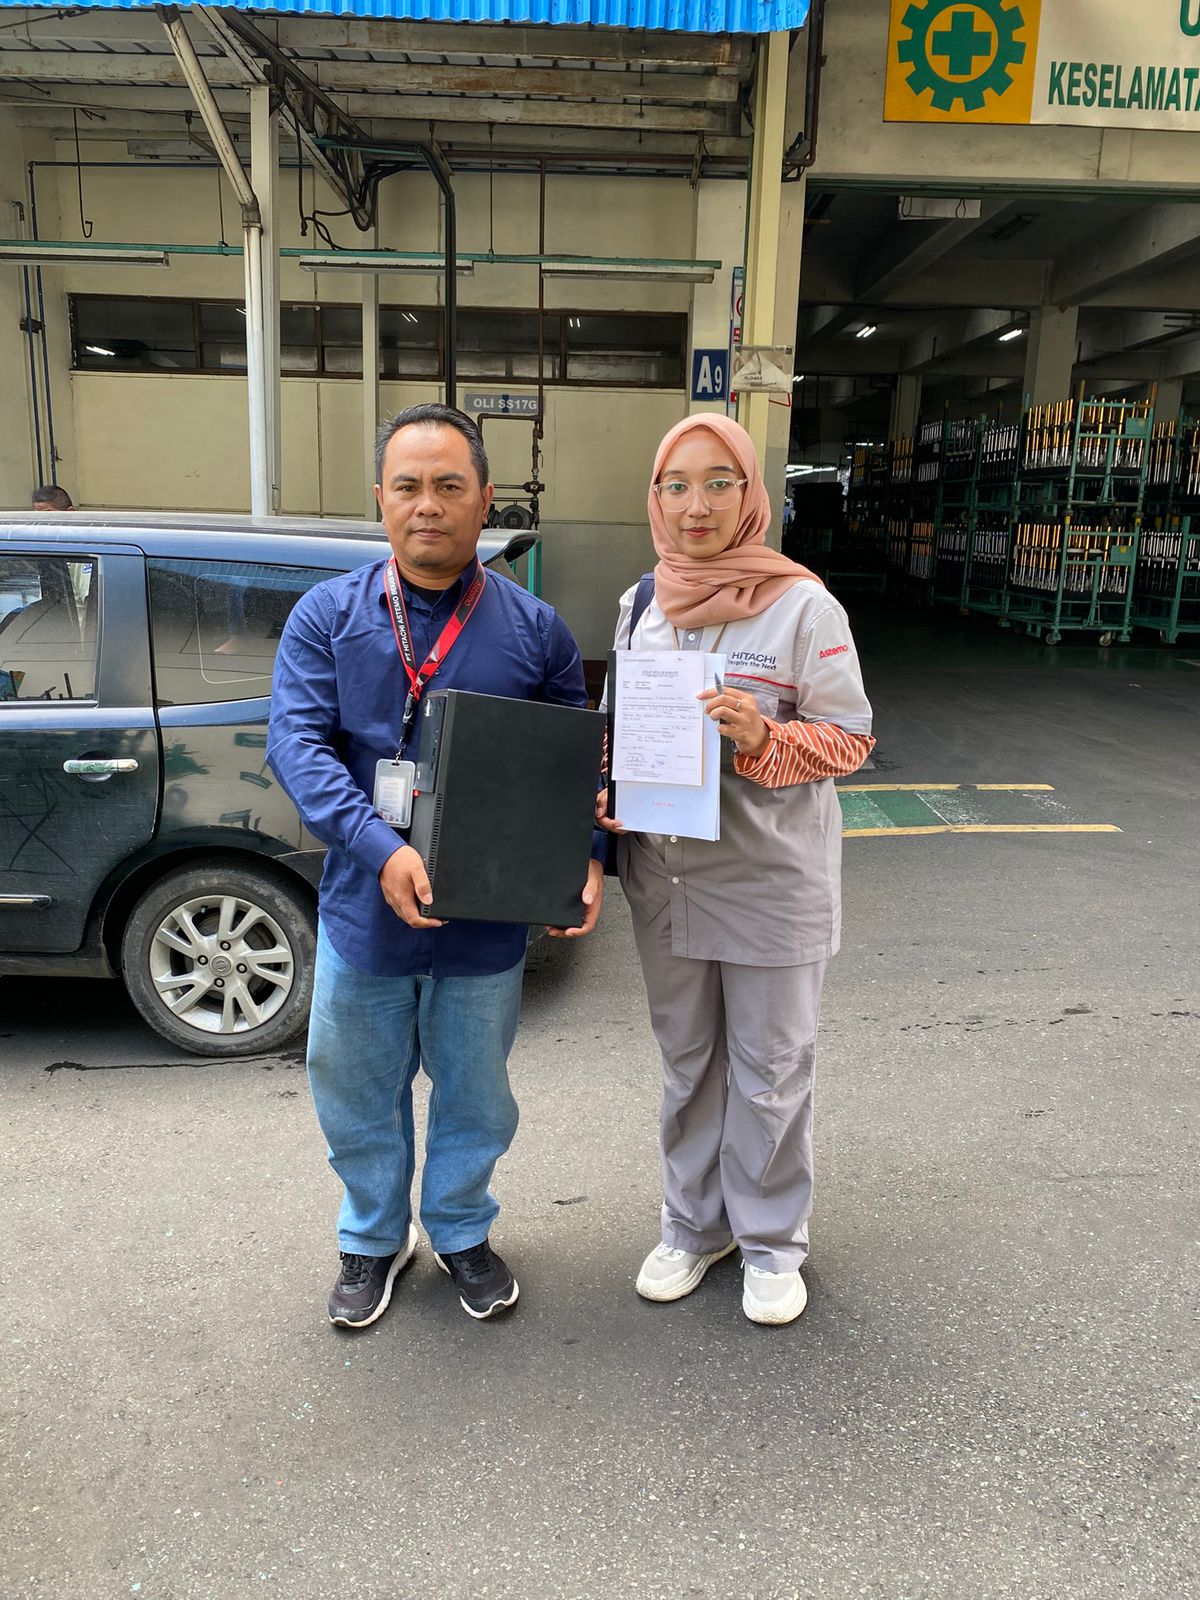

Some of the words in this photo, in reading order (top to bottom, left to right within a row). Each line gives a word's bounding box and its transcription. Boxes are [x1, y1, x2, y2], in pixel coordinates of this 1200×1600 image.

[696, 355, 723, 394] A9
[473, 398, 495, 409] OLI
[498, 398, 537, 410] SS17G
[392, 596, 404, 624] ASTEMO
[400, 624, 410, 652] HITACHI
[404, 651, 412, 662] PT
[731, 651, 777, 664] HITACHI
[818, 644, 849, 659] Astemo
[750, 660, 761, 669] the
[761, 662, 777, 671] Next
